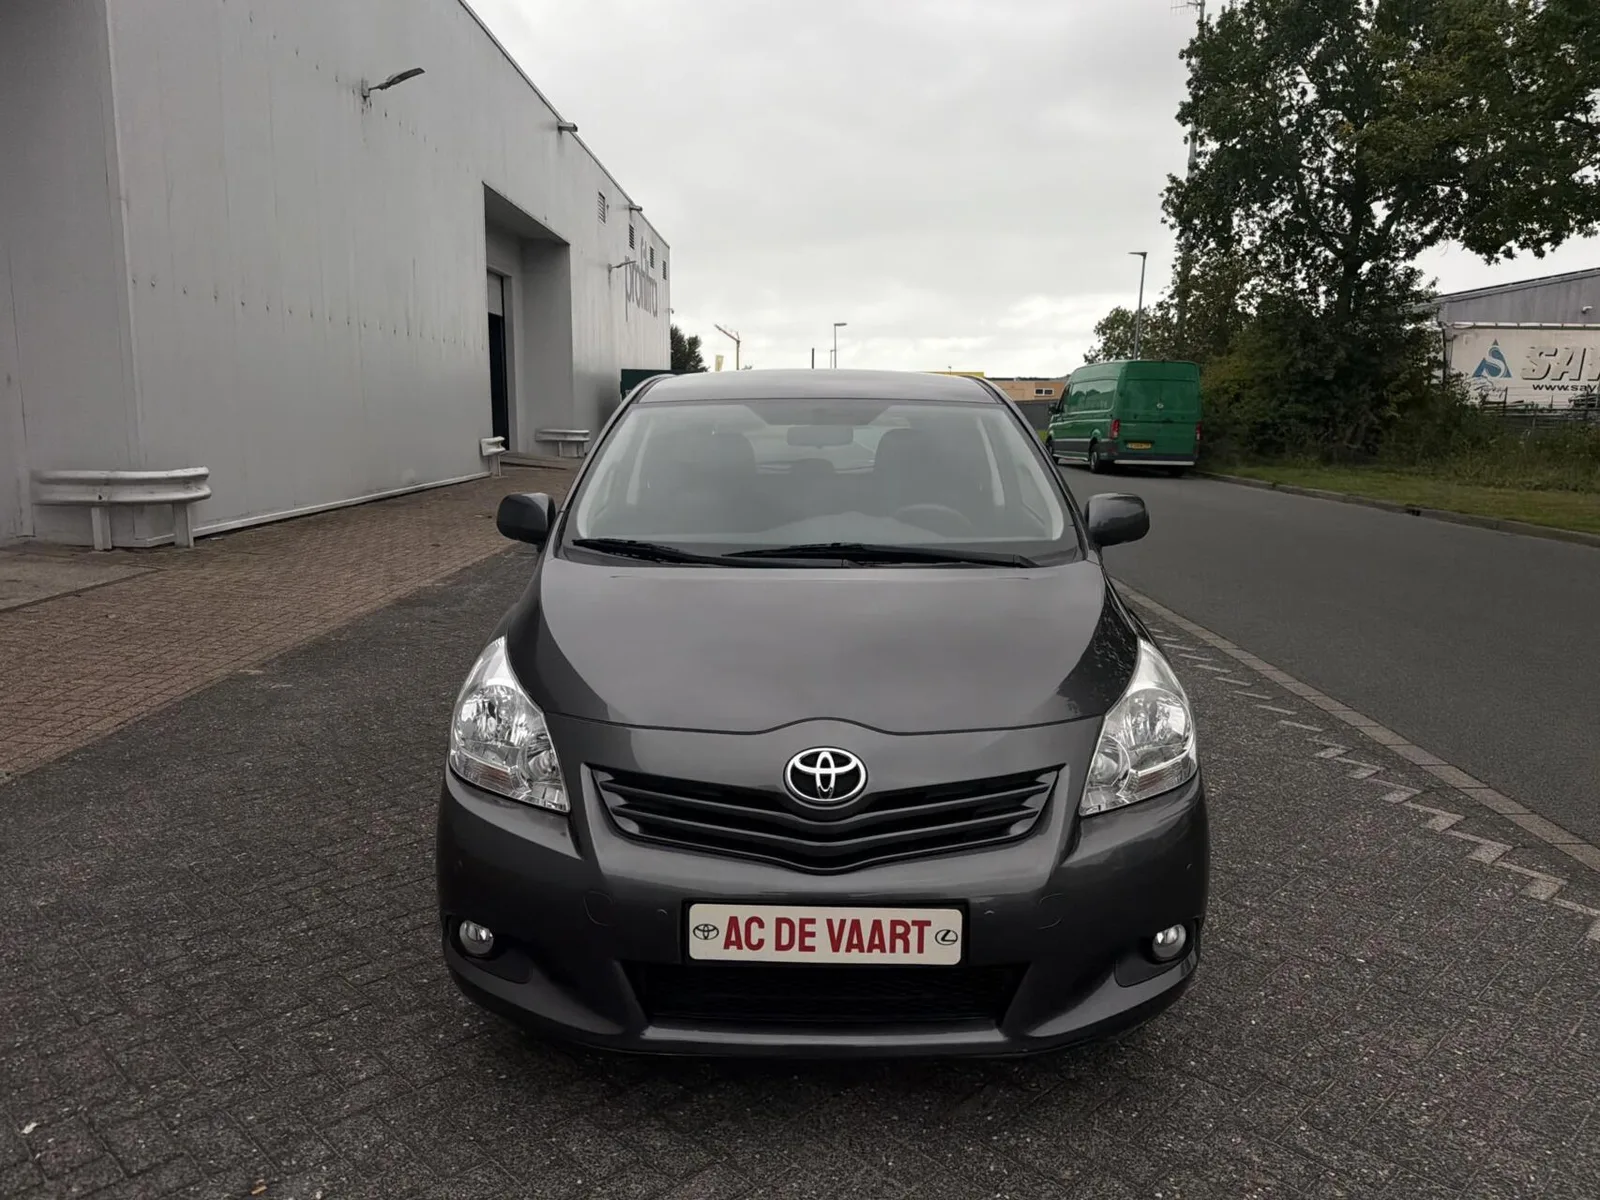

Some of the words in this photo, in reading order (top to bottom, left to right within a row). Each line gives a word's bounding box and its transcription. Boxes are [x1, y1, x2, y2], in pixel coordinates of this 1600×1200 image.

[723, 915, 765, 951] AC
[774, 917, 816, 952] DE
[826, 918, 932, 954] VAART
